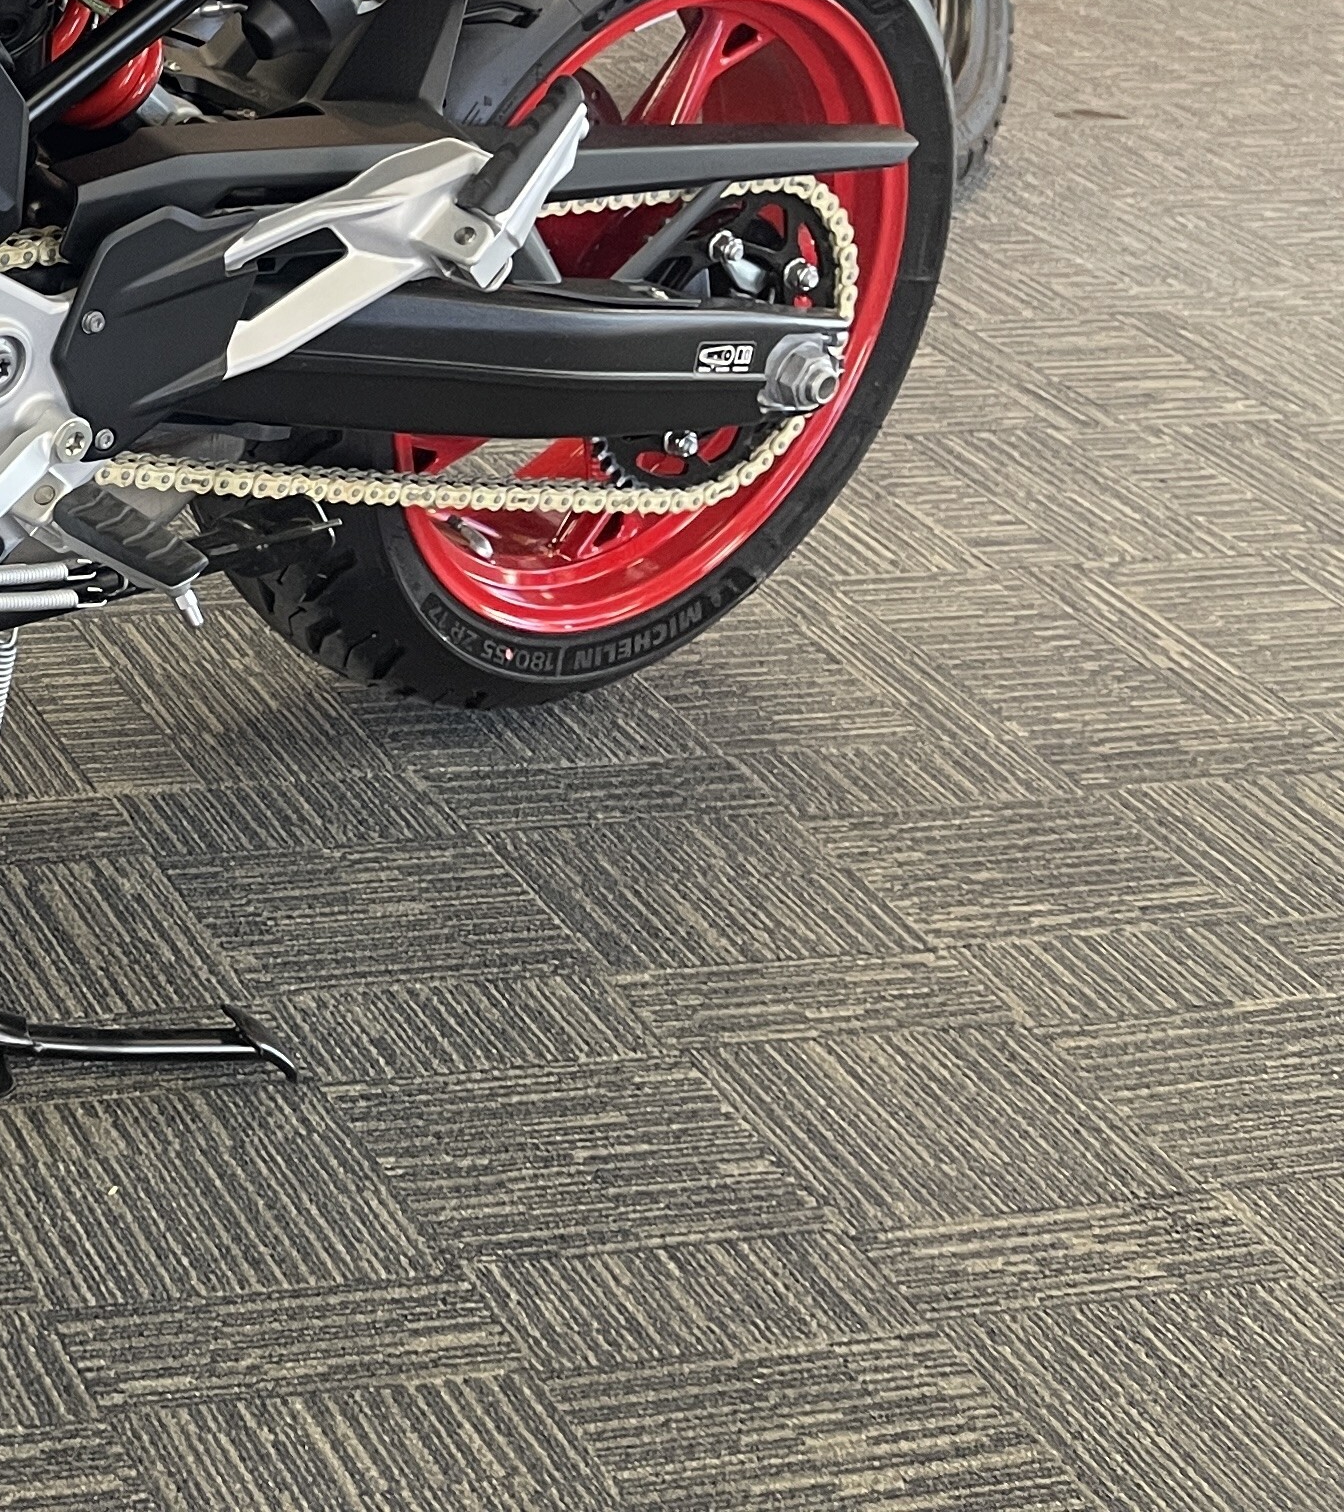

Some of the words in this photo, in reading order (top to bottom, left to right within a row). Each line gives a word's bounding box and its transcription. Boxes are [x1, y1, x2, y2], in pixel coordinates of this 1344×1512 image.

[427, 604, 449, 631] 17
[573, 600, 703, 671] MICHELIN
[482, 640, 555, 673] 180/55
